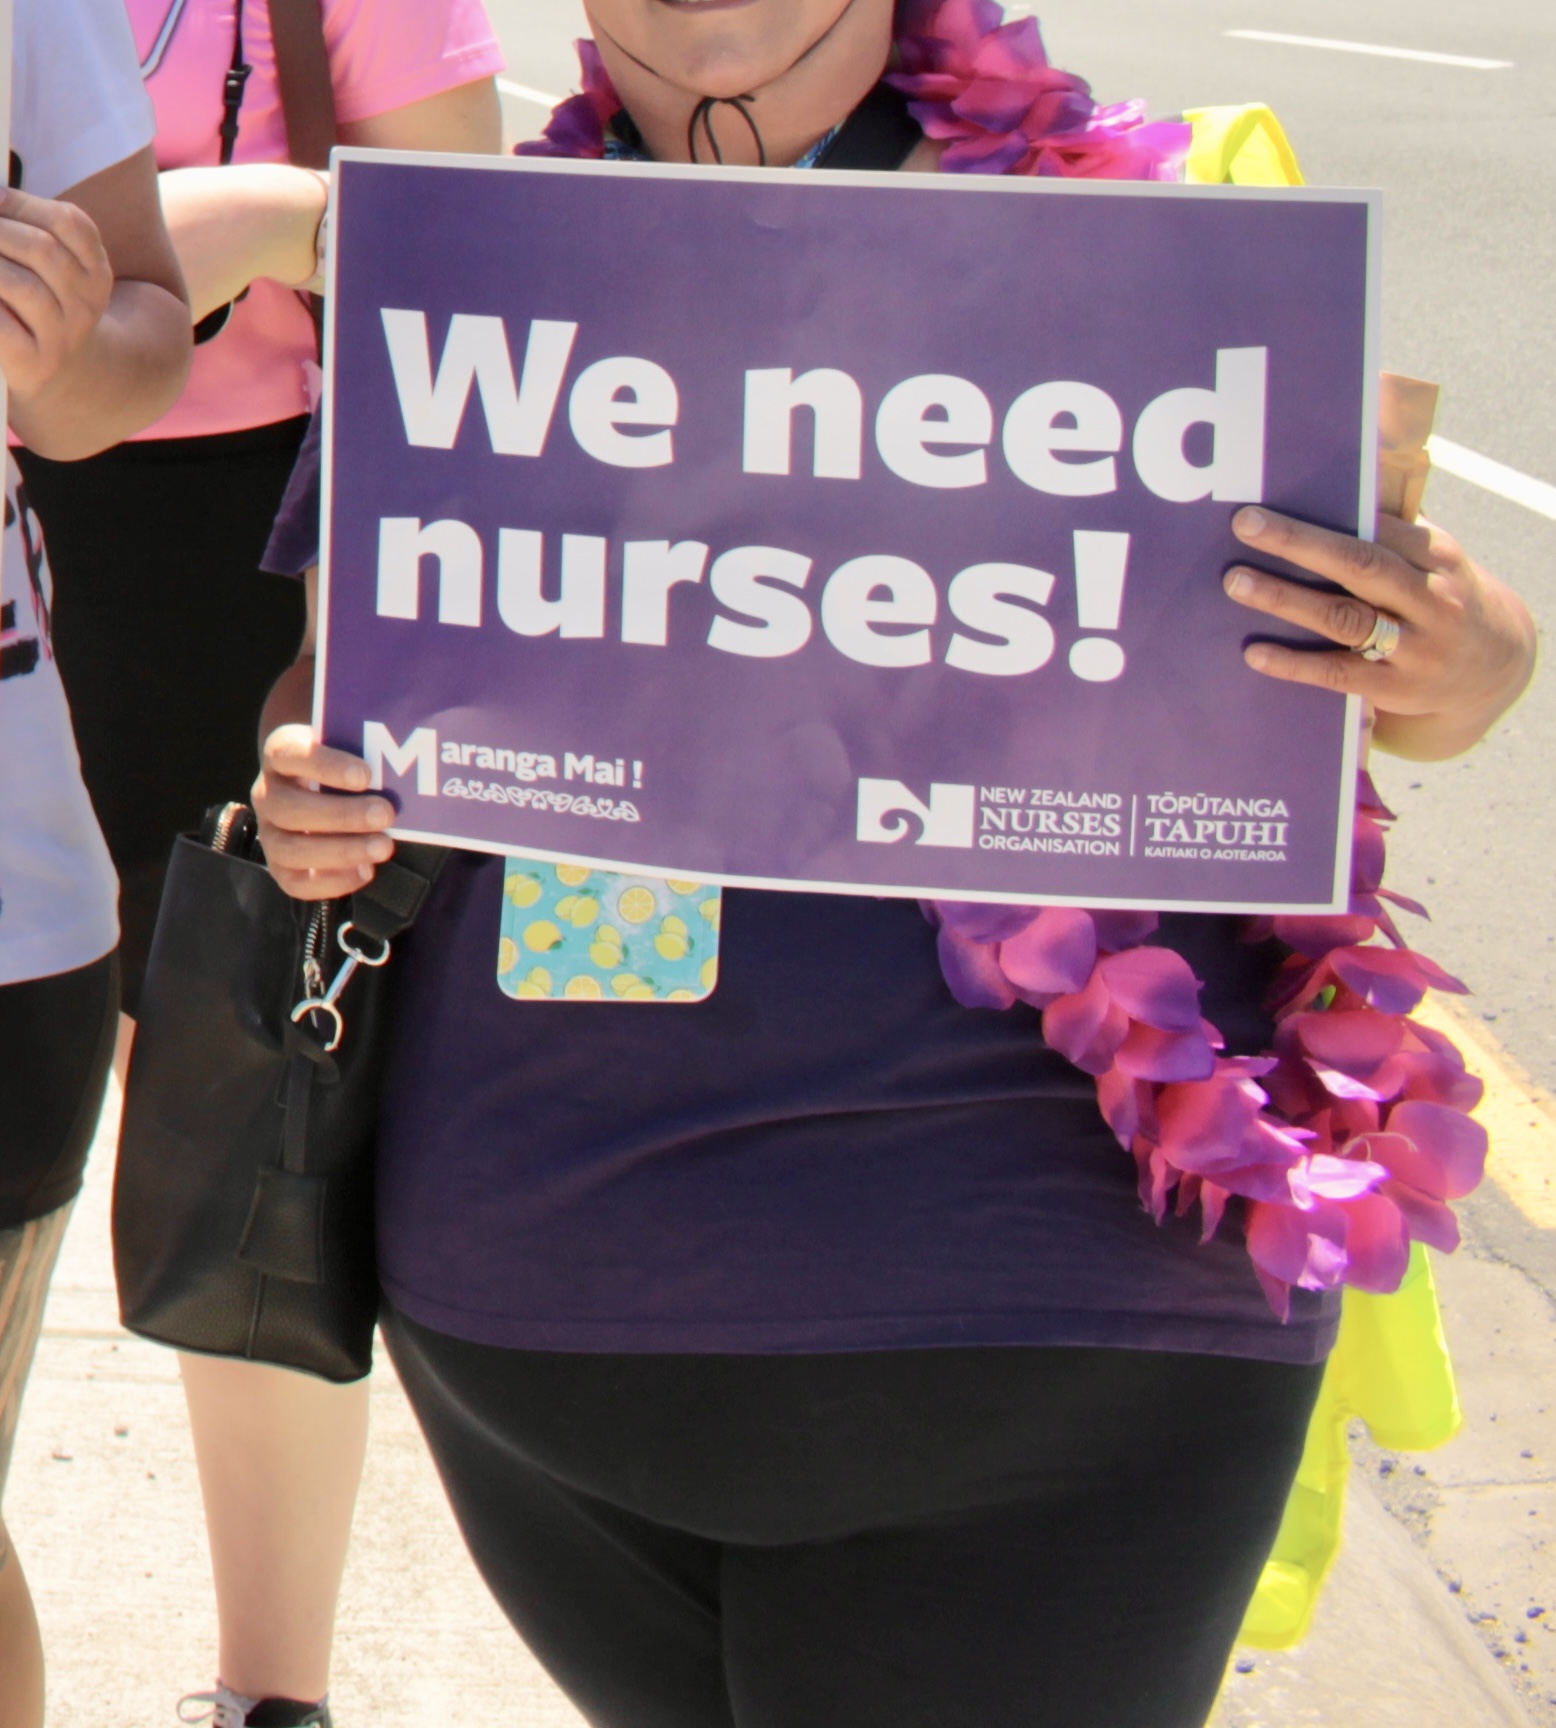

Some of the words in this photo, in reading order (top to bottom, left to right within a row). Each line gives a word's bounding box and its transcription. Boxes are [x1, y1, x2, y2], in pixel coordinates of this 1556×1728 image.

[380, 307, 678, 469] We
[742, 345, 1268, 504] need
[375, 515, 1130, 683] nurses!
[363, 720, 557, 796] Maranga
[980, 786, 1025, 804] NEW
[1030, 789, 1122, 810] ZEALAND
[1147, 792, 1289, 817] TŌPŪTANGA
[979, 807, 1122, 837] NURSES
[1145, 817, 1288, 846] TAPUHI
[979, 835, 1120, 856] ORGANISATION
[1145, 846, 1197, 859] KAITIAKI
[1200, 848, 1211, 859] O
[1213, 848, 1287, 862] AOTEAROA
